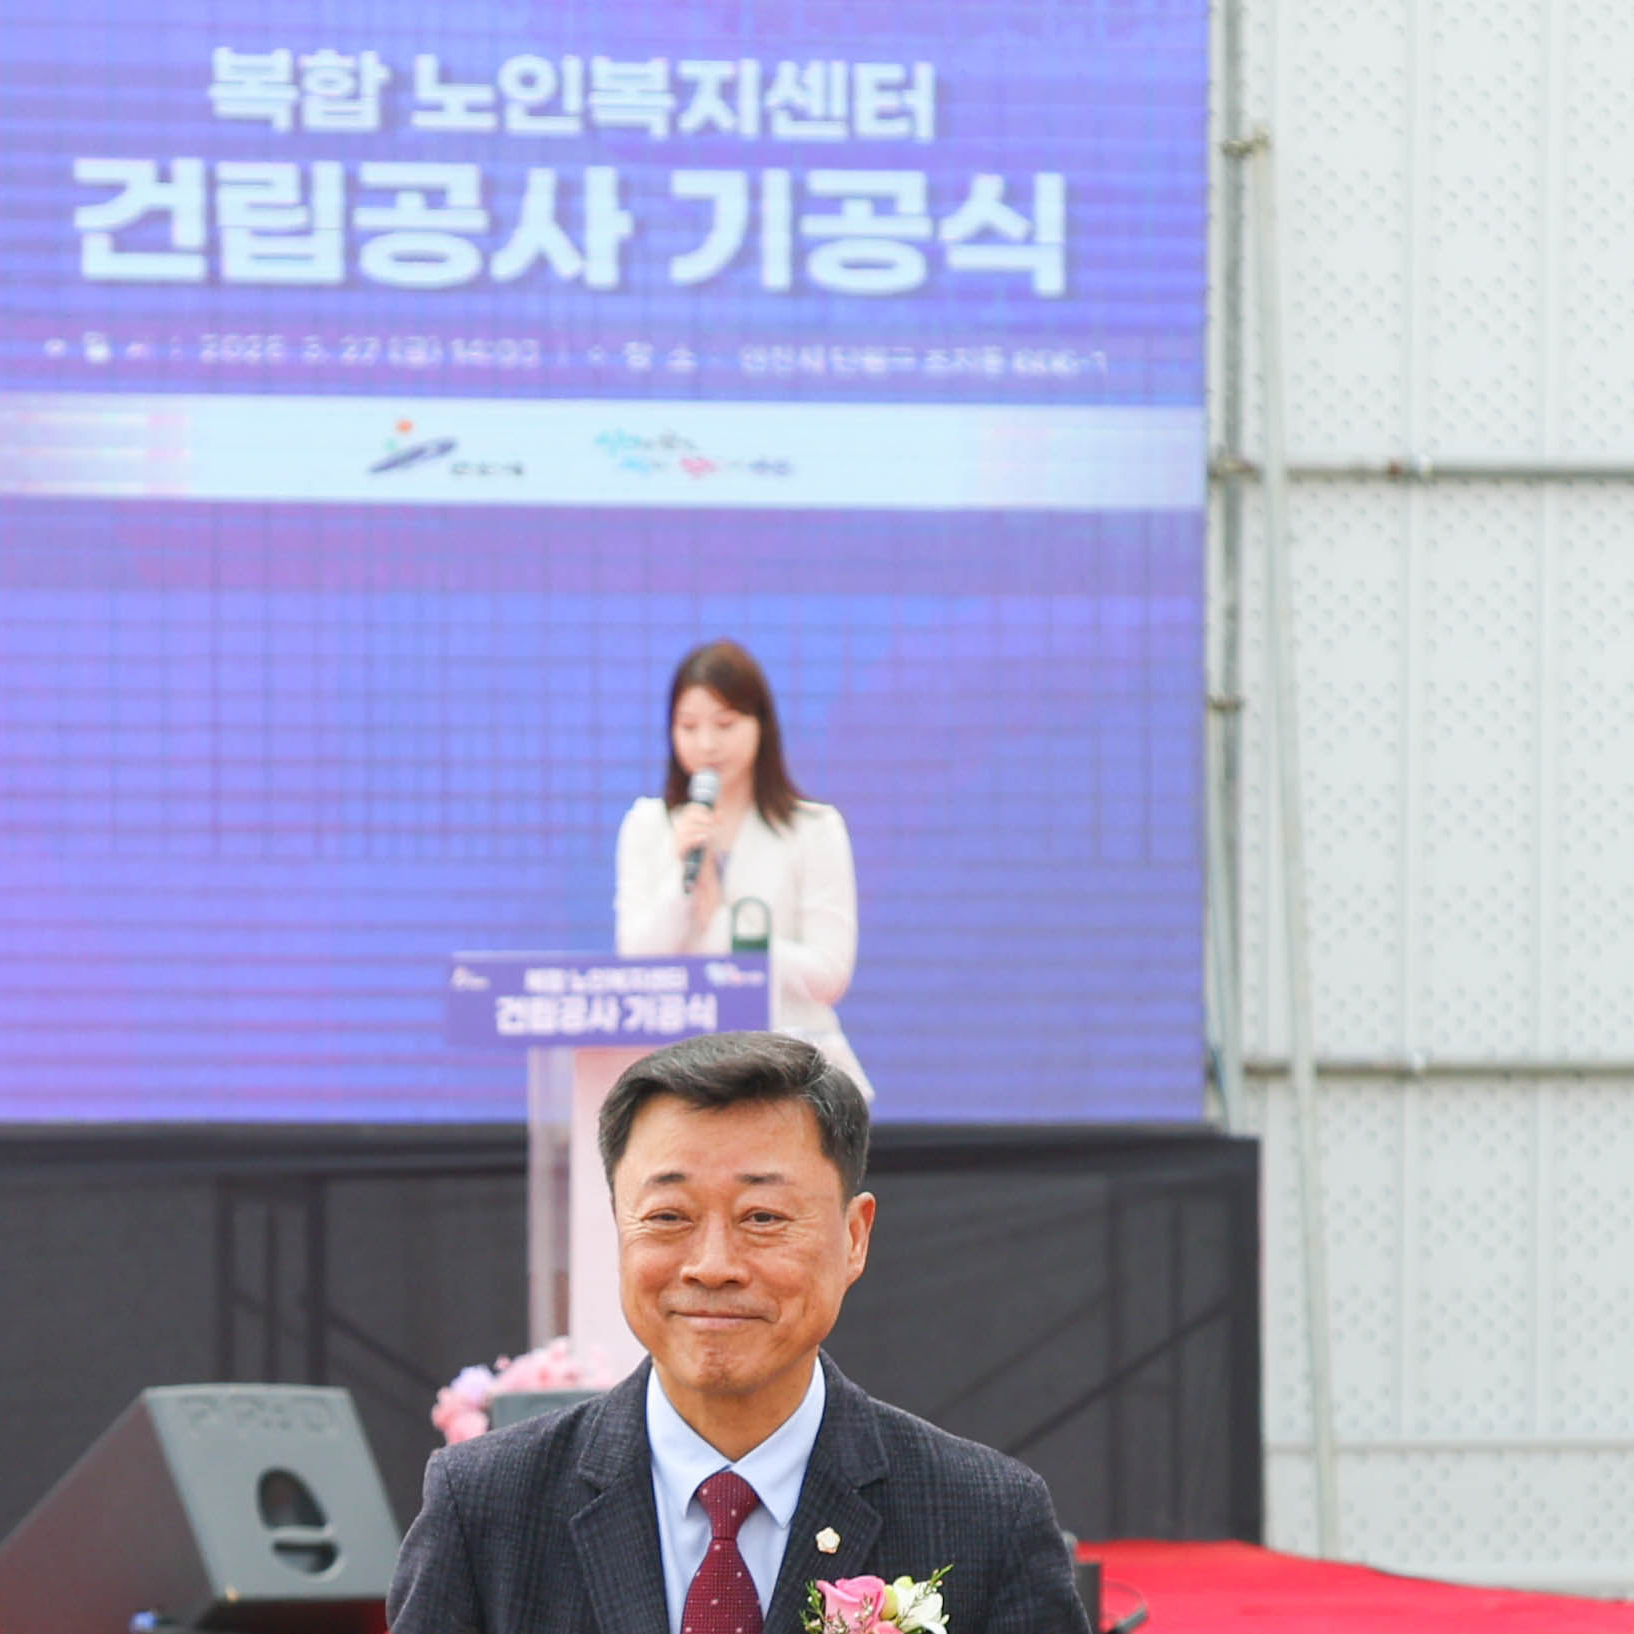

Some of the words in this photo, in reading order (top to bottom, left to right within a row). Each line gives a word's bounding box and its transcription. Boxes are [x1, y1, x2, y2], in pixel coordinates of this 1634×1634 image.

[208, 48, 386, 134] 복합
[411, 52, 937, 143] 노인복지센터
[73, 156, 633, 291] 건립공사
[668, 166, 1070, 297] 기공식
[496, 995, 620, 1035] 건립공사
[622, 993, 717, 1034] 기공식
